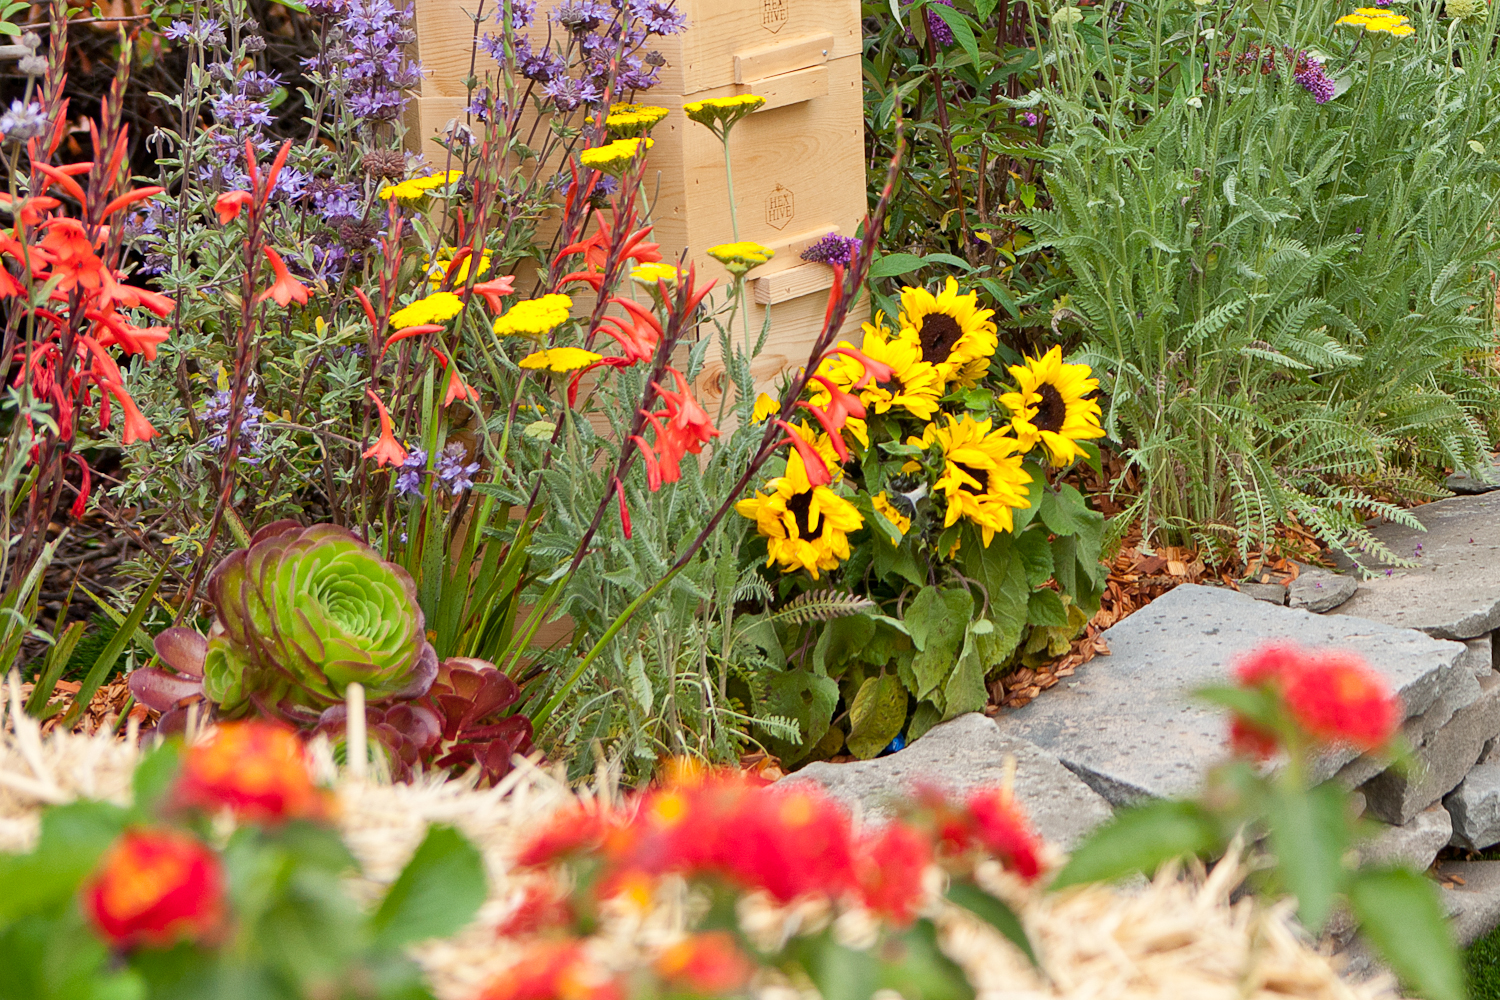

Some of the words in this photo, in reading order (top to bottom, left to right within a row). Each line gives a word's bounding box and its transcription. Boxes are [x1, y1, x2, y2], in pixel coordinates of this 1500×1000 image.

[763, 9, 786, 24] HIVE
[769, 194, 789, 209] HEX
[768, 205, 791, 221] HIVE
